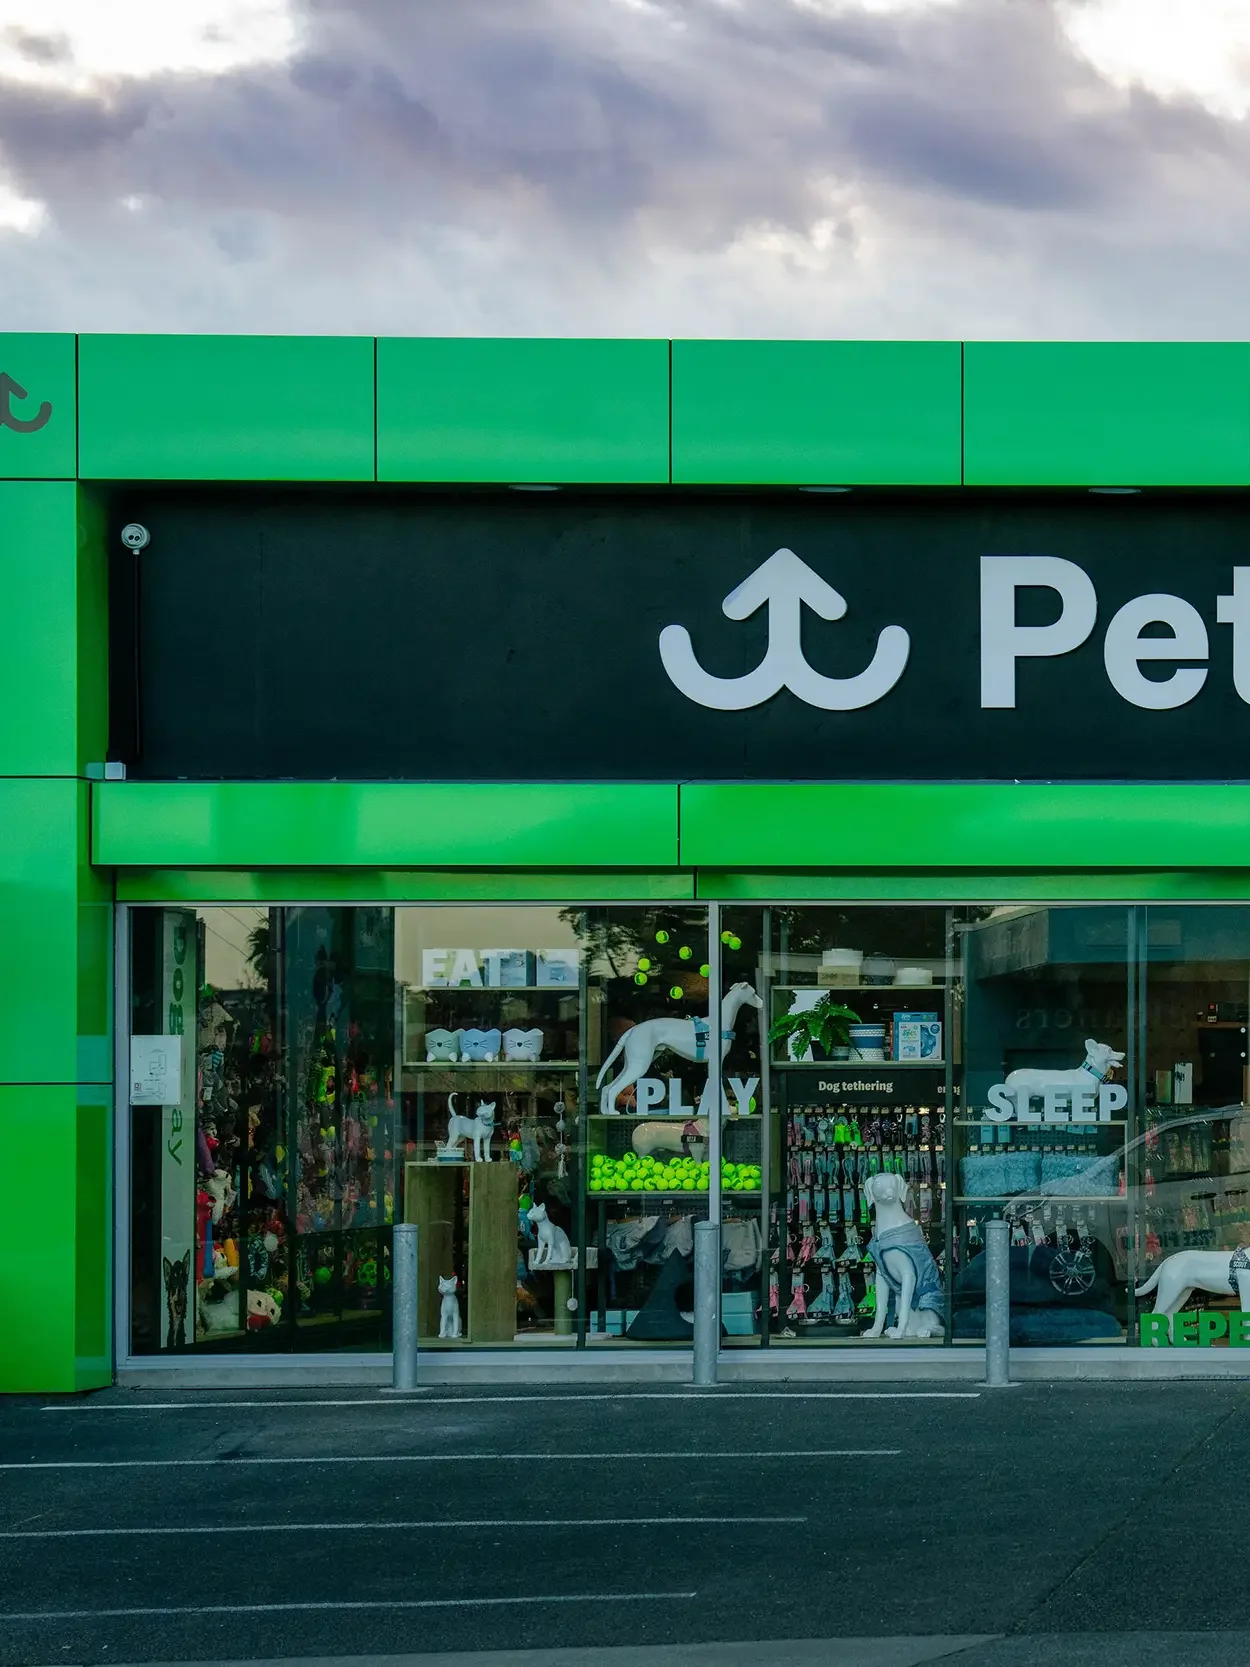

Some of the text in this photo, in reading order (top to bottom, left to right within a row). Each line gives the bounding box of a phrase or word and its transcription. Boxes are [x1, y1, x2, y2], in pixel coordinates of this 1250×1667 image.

[422, 949, 511, 987] EAT
[637, 1077, 760, 1116] PLAY
[818, 1080, 894, 1094] Dog tethering
[985, 1083, 1128, 1122] SLEEP
[1233, 1260, 1248, 1269] SCOUT
